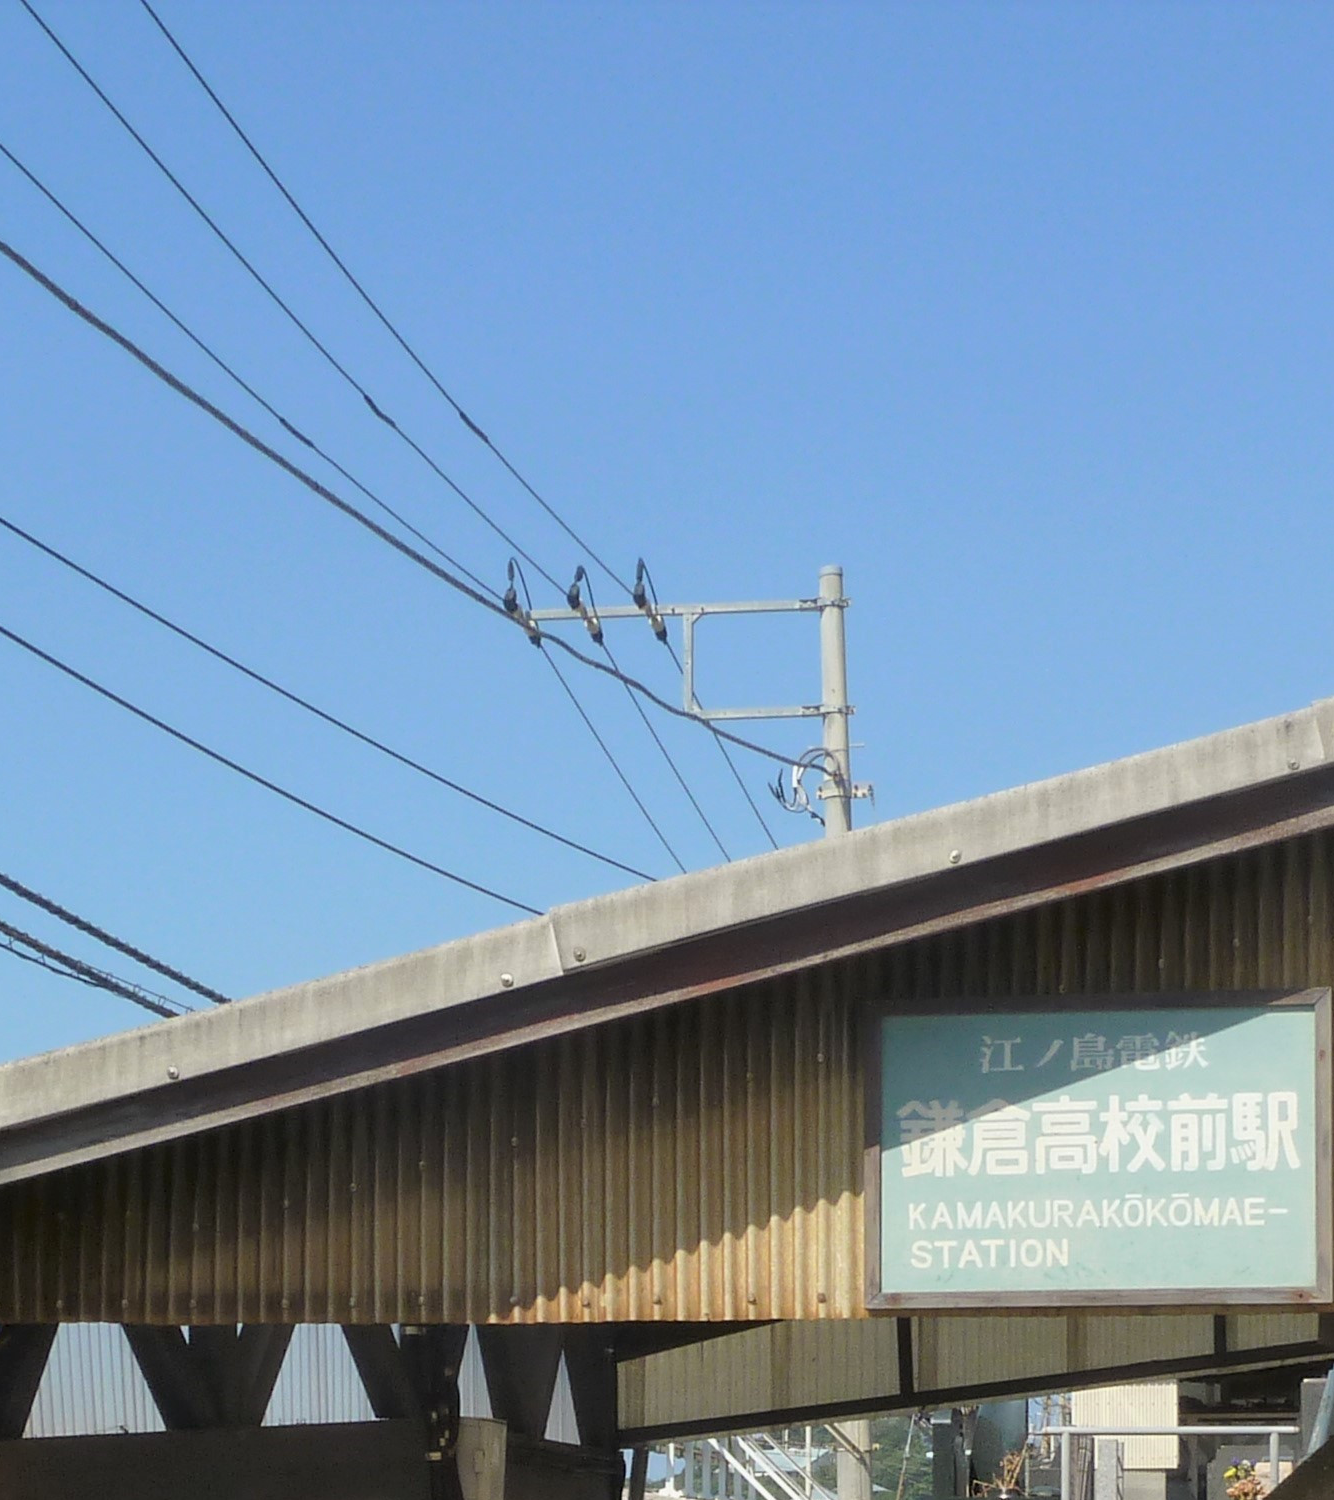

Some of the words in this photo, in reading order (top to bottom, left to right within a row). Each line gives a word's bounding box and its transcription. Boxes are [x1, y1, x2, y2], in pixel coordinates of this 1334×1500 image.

[979, 1031, 1209, 1074] 江ノ島電鉄
[898, 1090, 1302, 1179] 鎌倉高校前駅
[909, 1238, 1070, 1269] STATION
